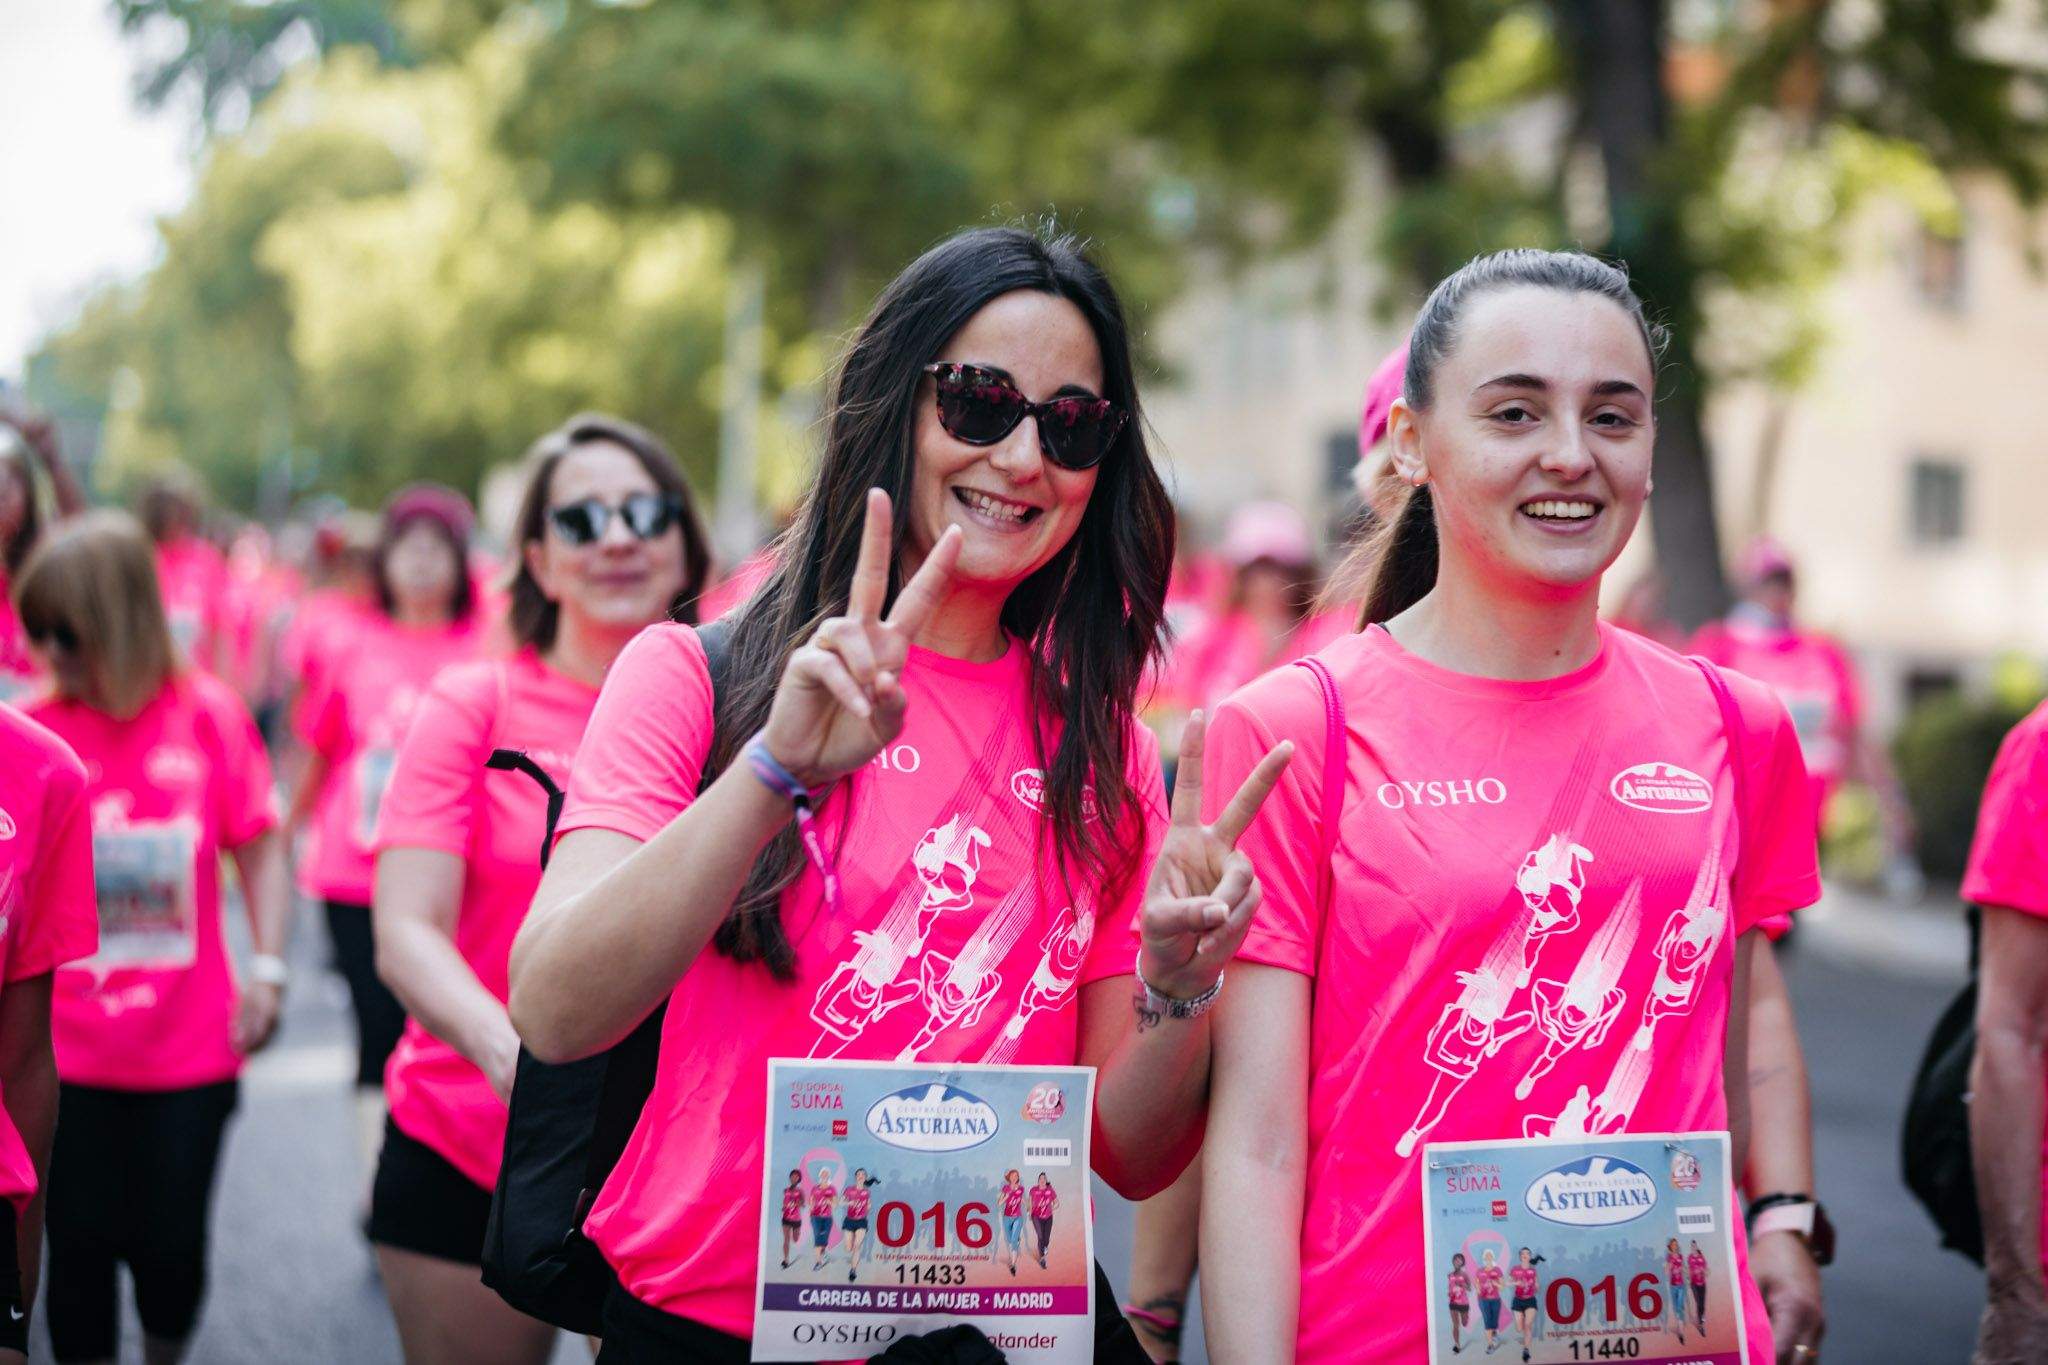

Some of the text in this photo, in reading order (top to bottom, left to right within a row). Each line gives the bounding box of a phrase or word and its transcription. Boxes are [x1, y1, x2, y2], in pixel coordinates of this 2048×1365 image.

[1377, 778, 1507, 809] OYSHO
[791, 1093, 844, 1109] SUMA
[1030, 1087, 1062, 1109] 20
[877, 1107, 989, 1135] ASTURIANA
[1446, 1175, 1503, 1194] SUMA
[1537, 1184, 1651, 1211] ASTURIANA
[876, 1201, 993, 1249] 016
[895, 1264, 966, 1285] 11433
[798, 1289, 1054, 1309] CARRERA DE LA MUJER MADRID
[1545, 1272, 1663, 1325] 016
[793, 1323, 896, 1343] OYSHO
[1569, 1337, 1640, 1360] 11440
